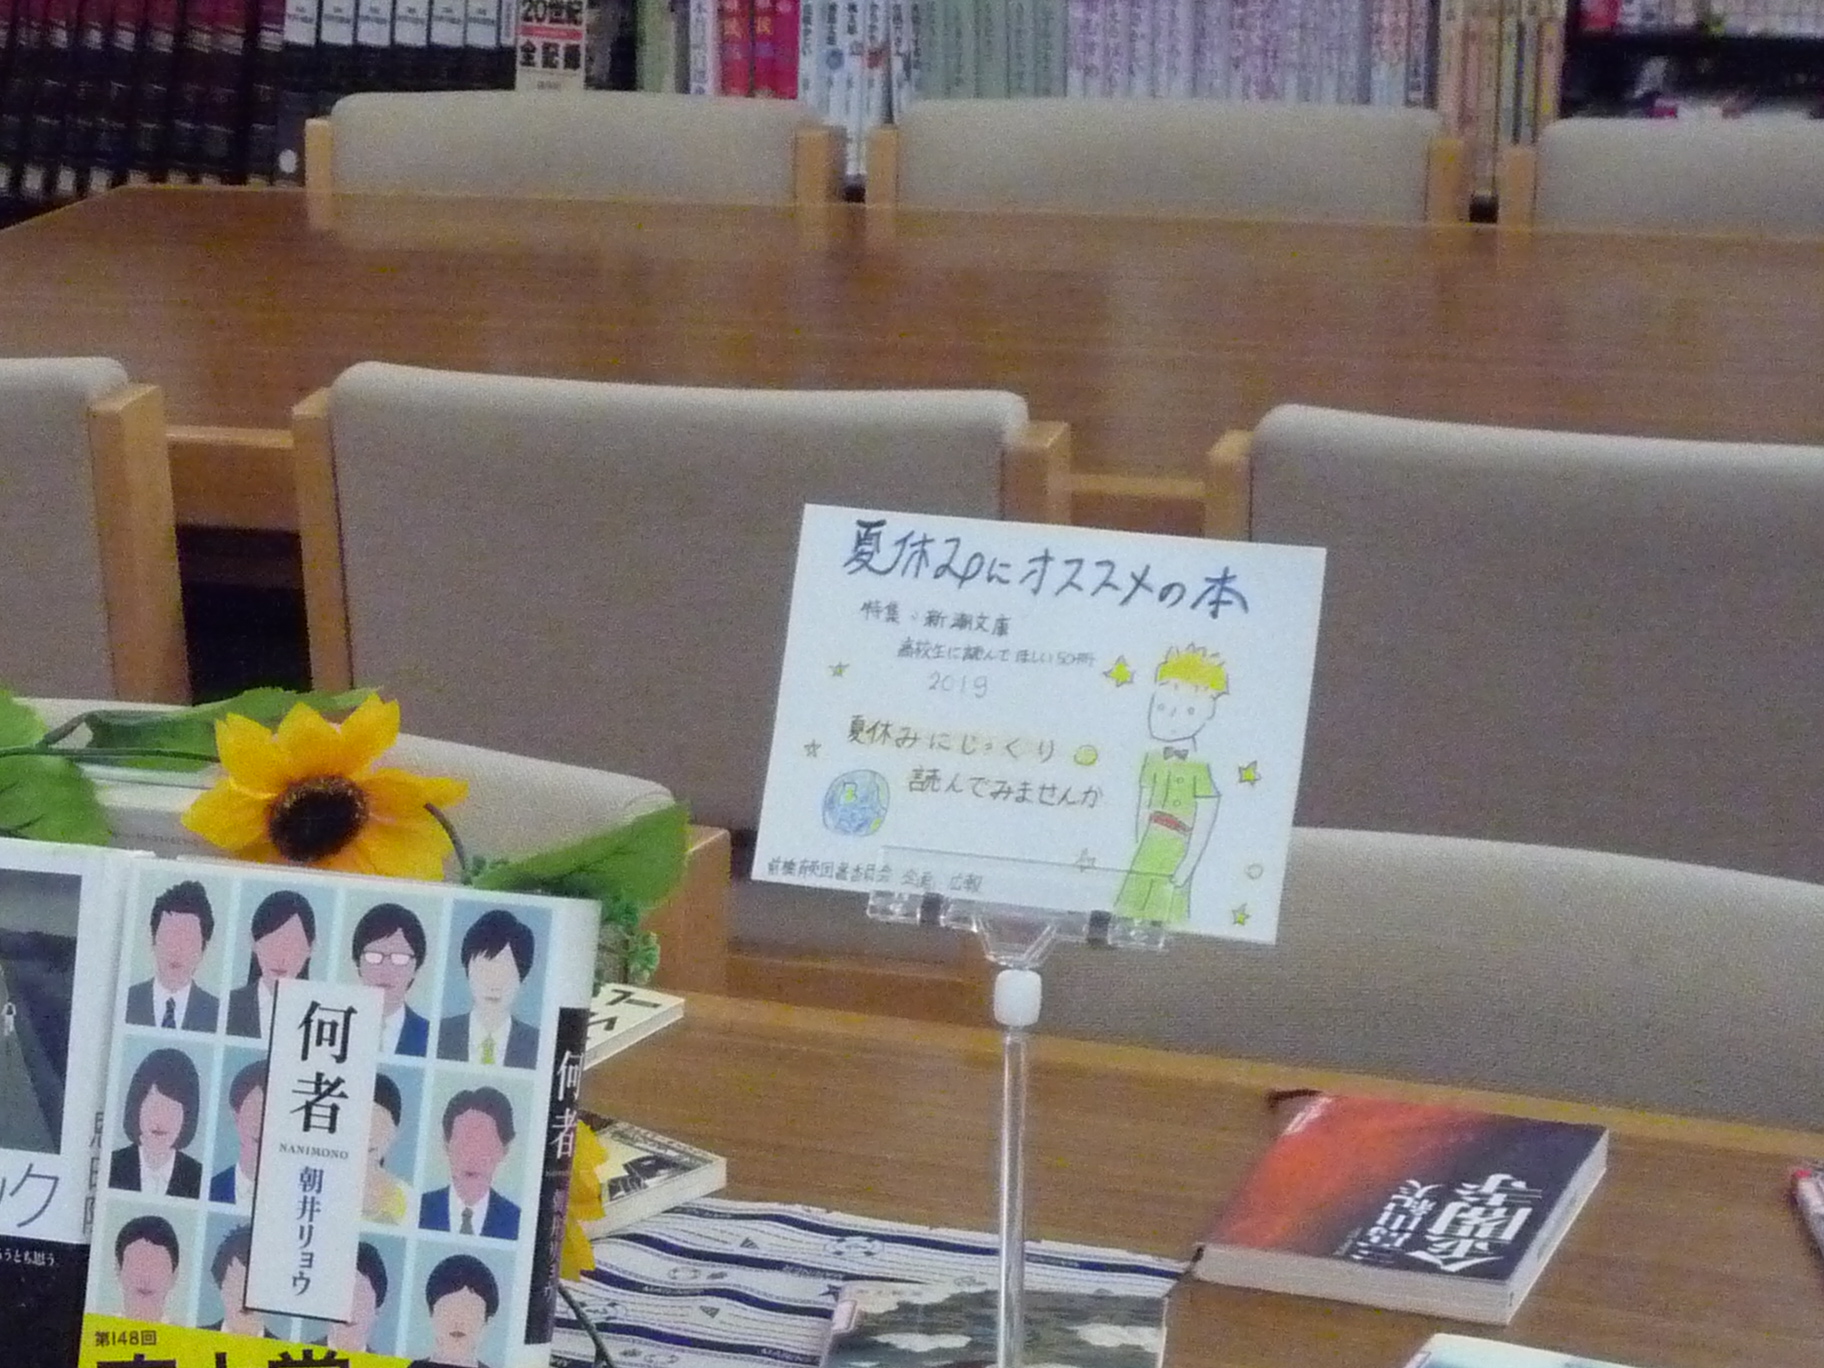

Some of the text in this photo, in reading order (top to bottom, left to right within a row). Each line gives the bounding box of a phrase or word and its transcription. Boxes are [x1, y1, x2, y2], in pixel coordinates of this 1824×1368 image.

[288, 998, 359, 1138] 何者
[278, 1141, 351, 1162] NANIMONO
[290, 1164, 327, 1299] 朝井リョウ
[1406, 1172, 1543, 1274] 金閣寺
[93, 1328, 158, 1348] 第148回
